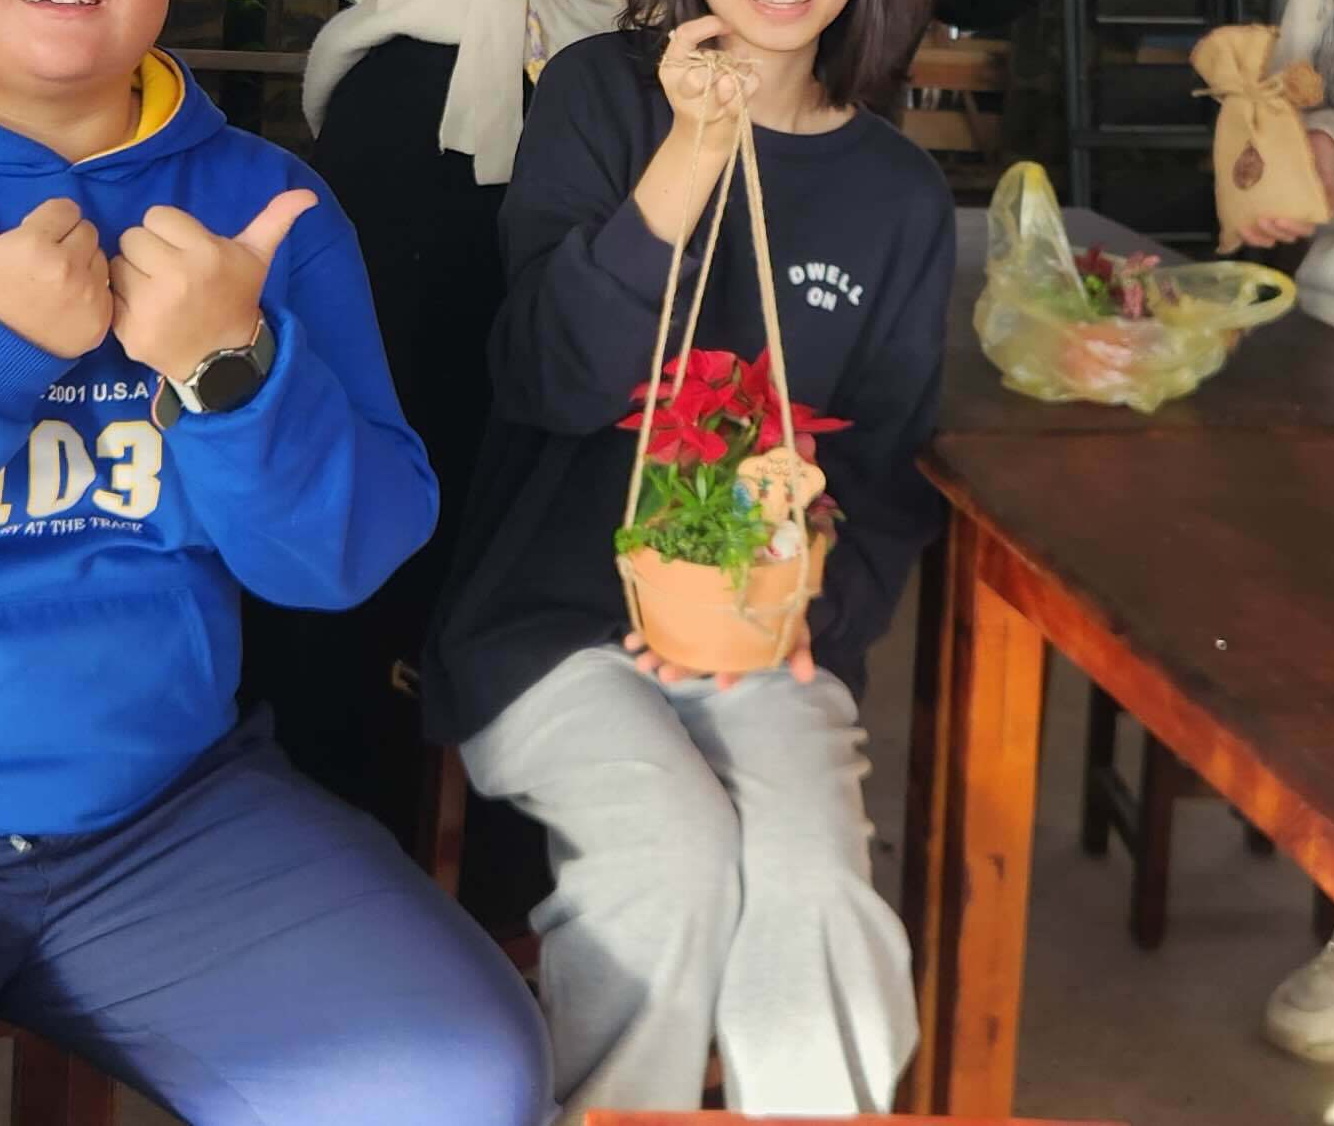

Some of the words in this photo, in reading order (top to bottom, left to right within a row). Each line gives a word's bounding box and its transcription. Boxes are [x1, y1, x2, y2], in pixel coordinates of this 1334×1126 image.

[788, 261, 864, 307] DWELL
[806, 286, 838, 312] ON
[48, 384, 86, 403] 2001
[92, 381, 150, 403] U.S.A
[24, 520, 47, 537] AT
[50, 517, 87, 535] THE
